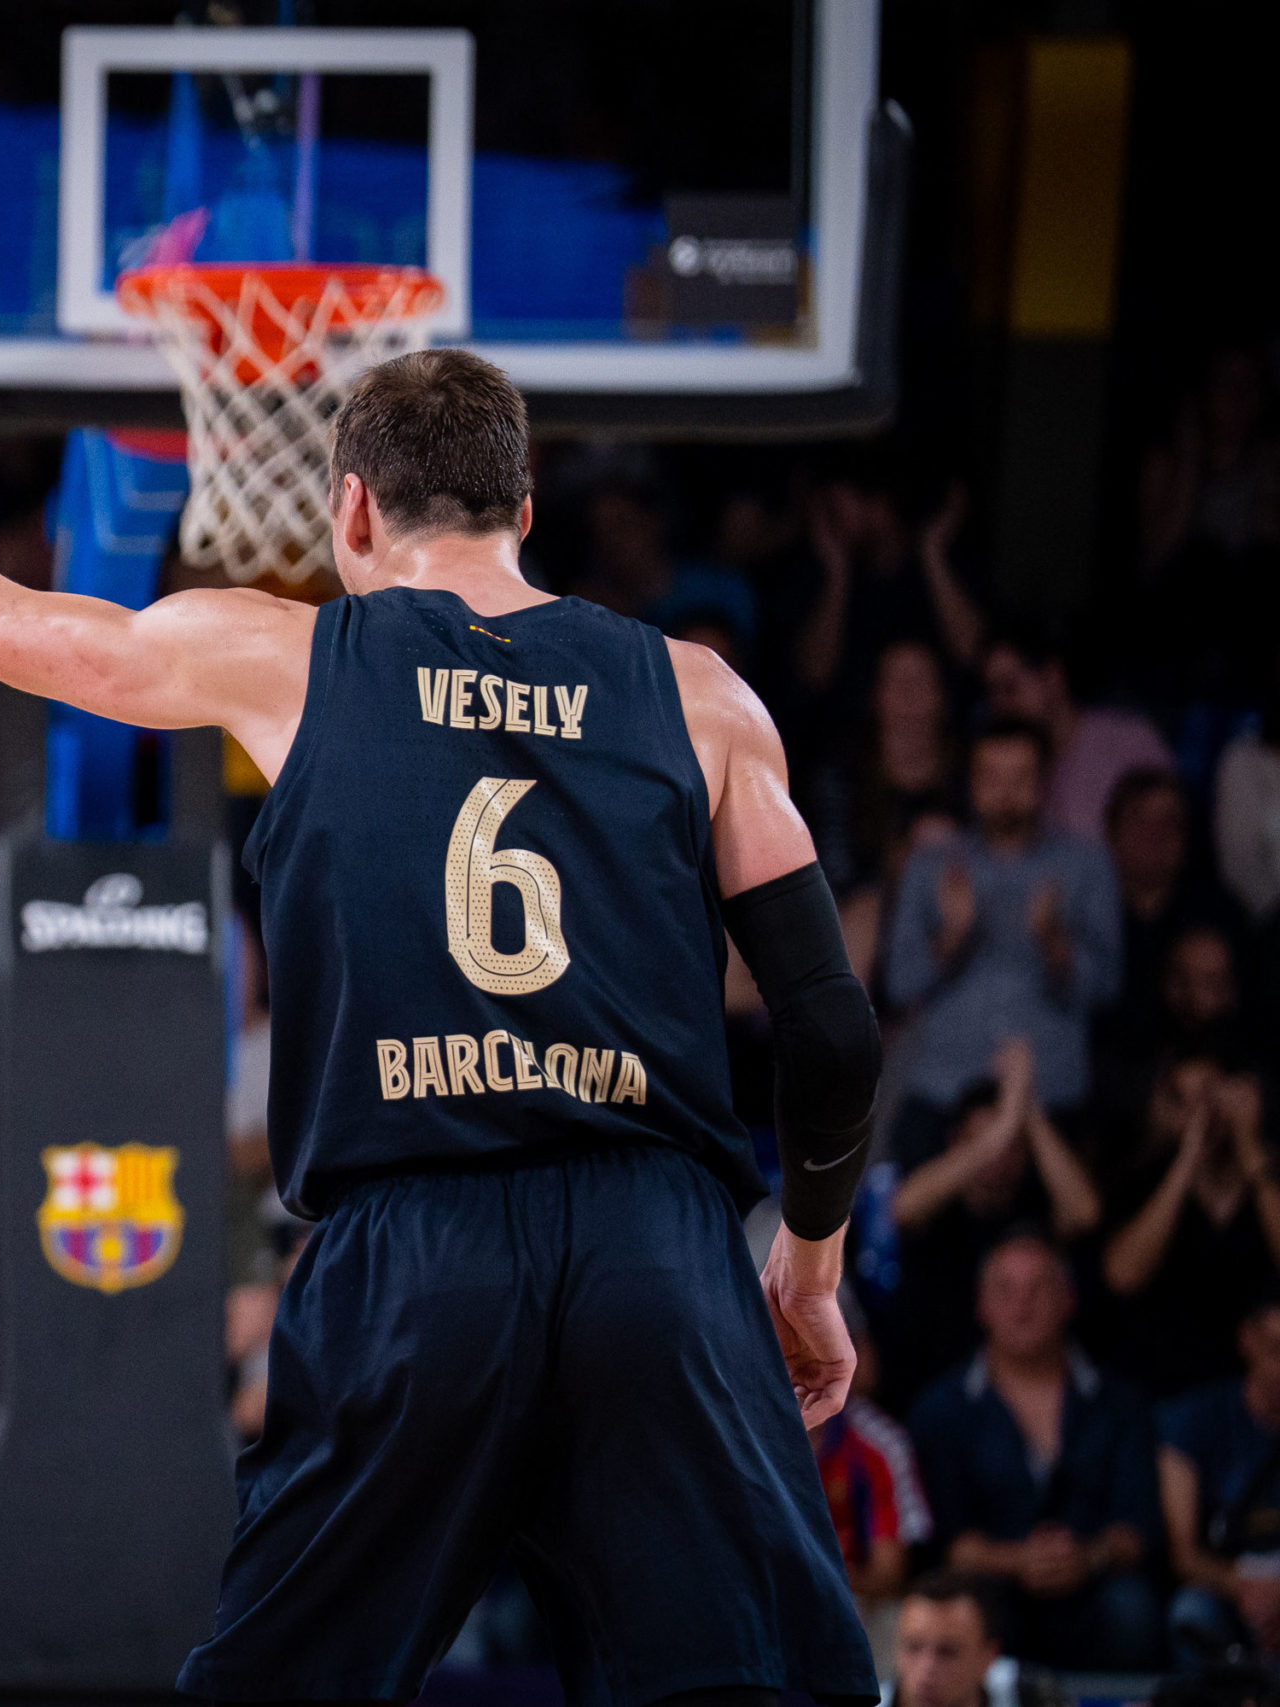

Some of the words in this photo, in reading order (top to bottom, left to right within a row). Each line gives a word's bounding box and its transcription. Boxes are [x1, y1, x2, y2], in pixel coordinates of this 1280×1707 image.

[418, 666, 588, 739] VESELY
[445, 776, 571, 995] 6
[376, 1030, 647, 1104] BARCELONA
